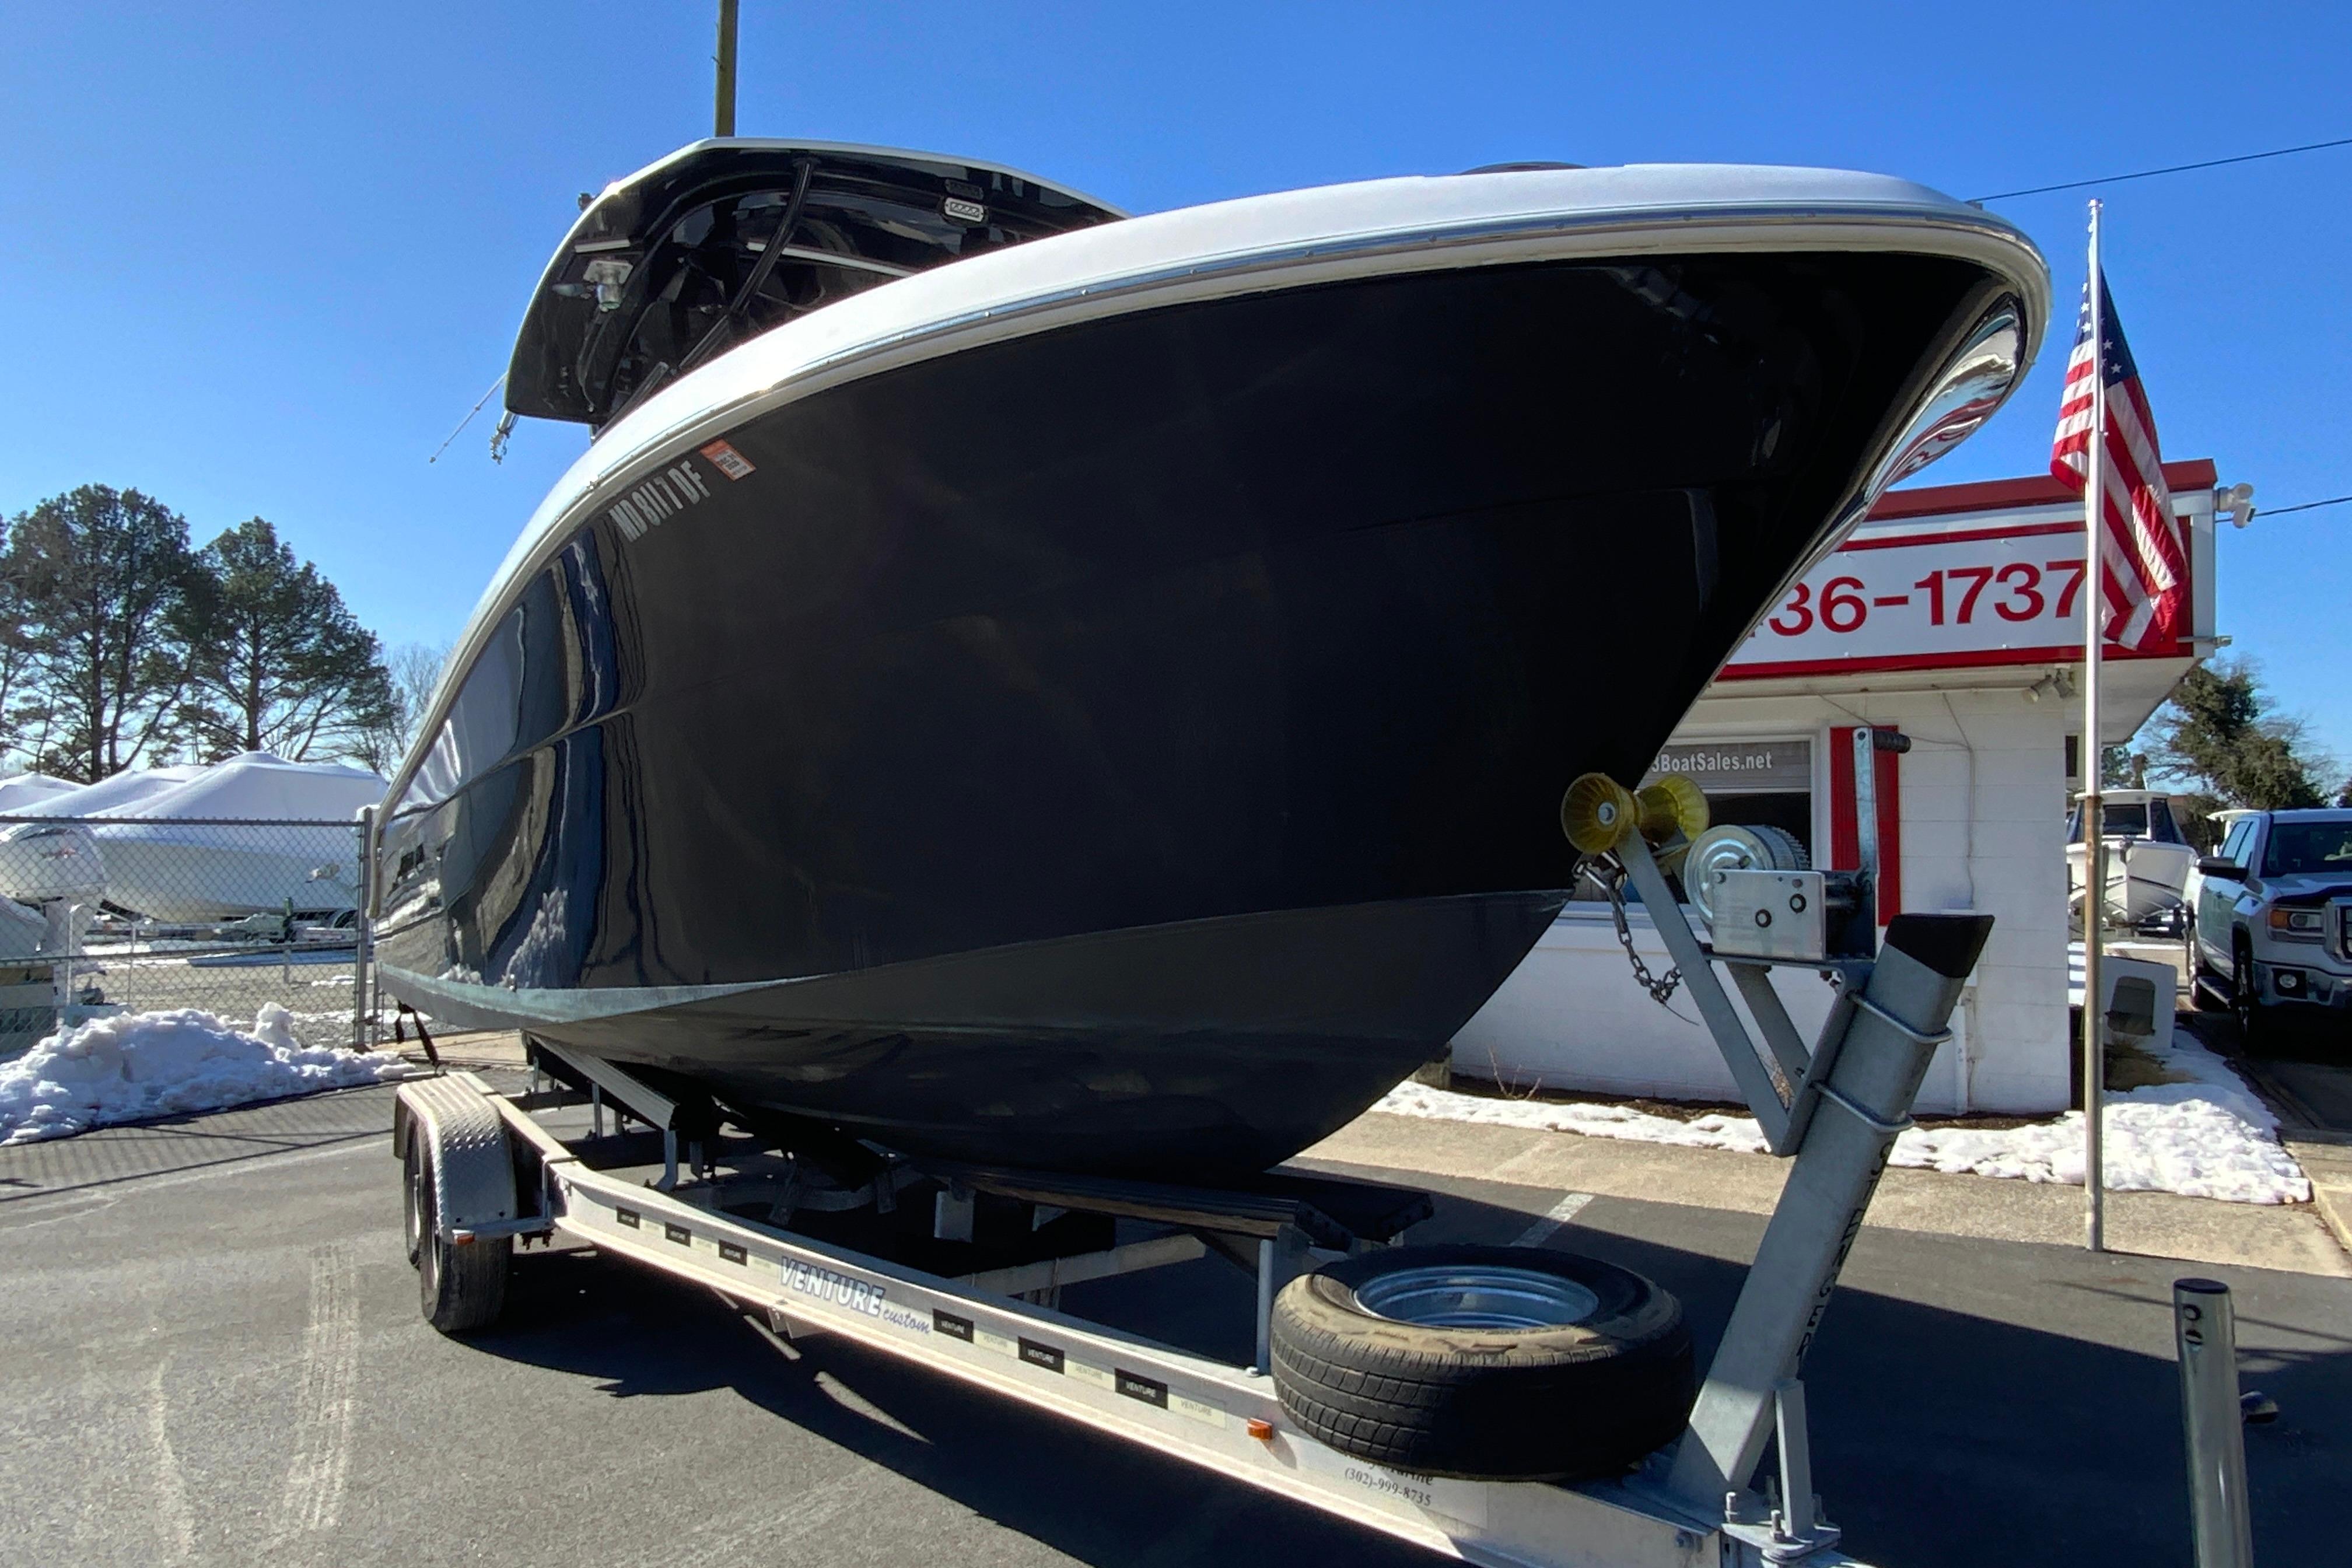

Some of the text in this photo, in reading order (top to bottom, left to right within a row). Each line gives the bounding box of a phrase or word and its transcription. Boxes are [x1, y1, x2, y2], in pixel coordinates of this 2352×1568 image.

[1748, 559, 2087, 638] 36-1737
[780, 1255, 932, 1334] VENTURE custom
[1125, 1380, 1157, 1398] VENTURE
[1180, 1399, 1213, 1416] VENTURE
[1344, 1467, 1432, 1507] (302)-999-8735
